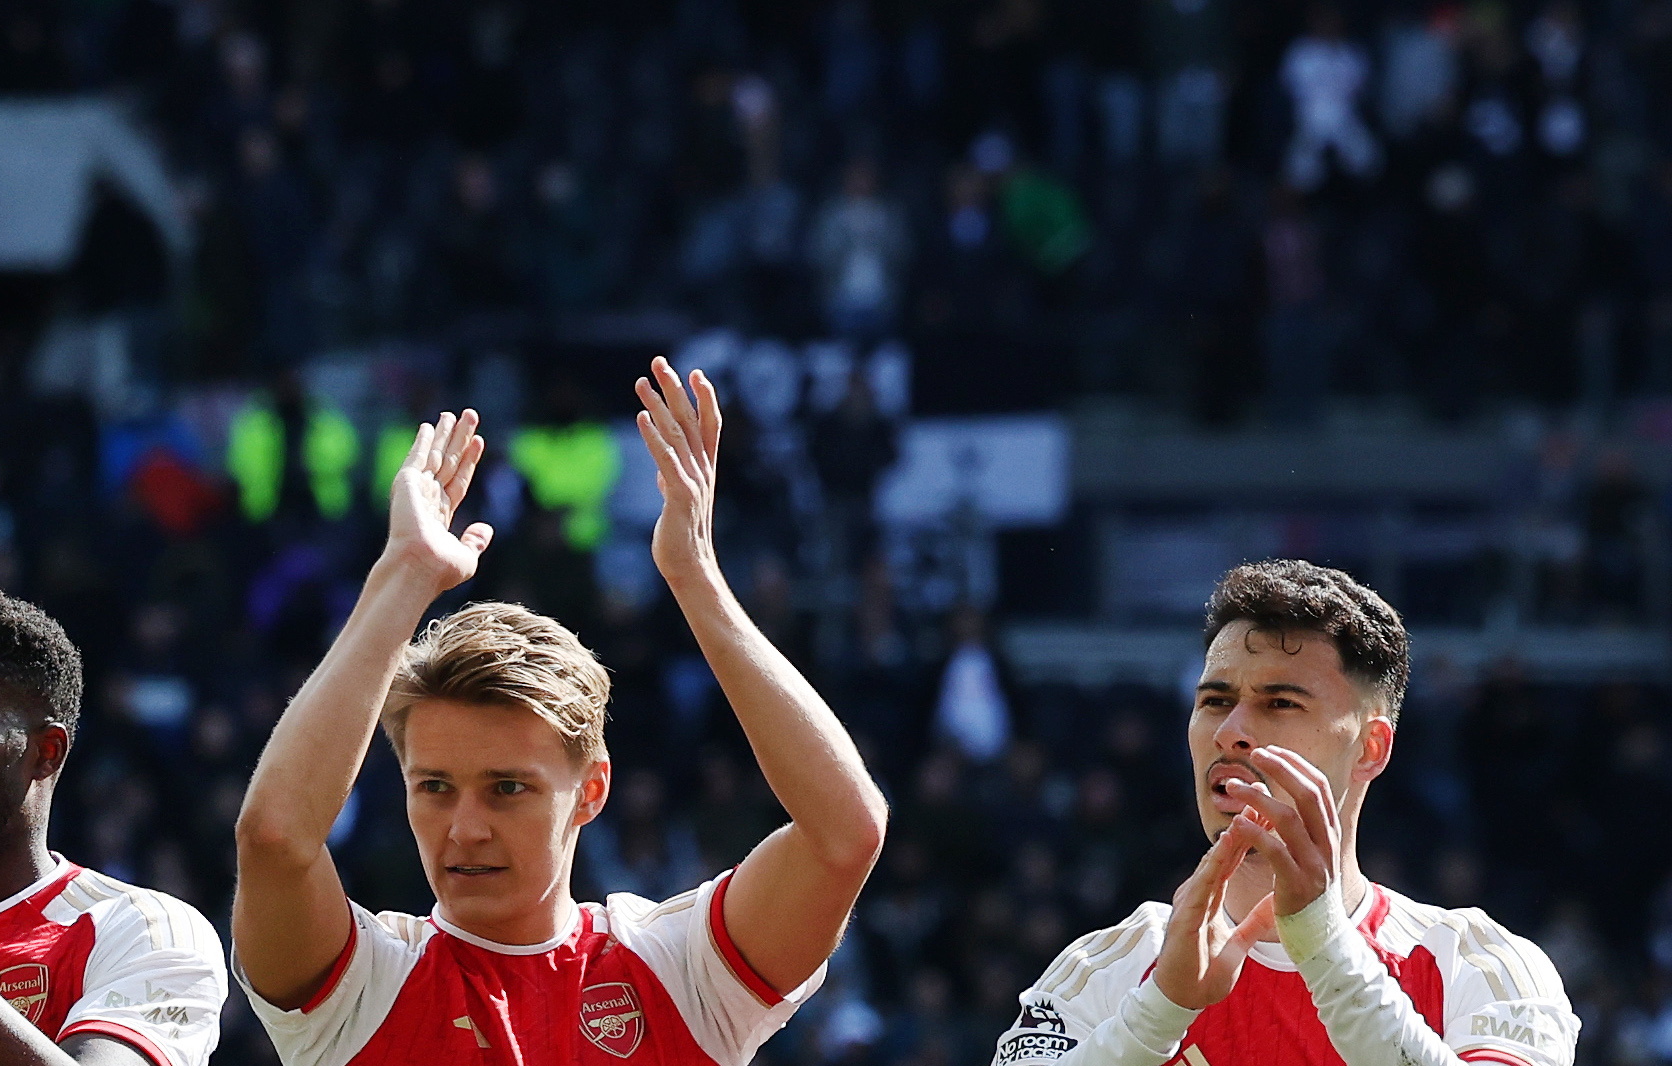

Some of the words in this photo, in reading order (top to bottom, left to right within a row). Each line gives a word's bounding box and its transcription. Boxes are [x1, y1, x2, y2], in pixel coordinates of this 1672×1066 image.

[0, 975, 41, 993] Arsenal
[582, 994, 630, 1014] Arsenal
[999, 1042, 1017, 1059] No
[1018, 1035, 1068, 1051] room
